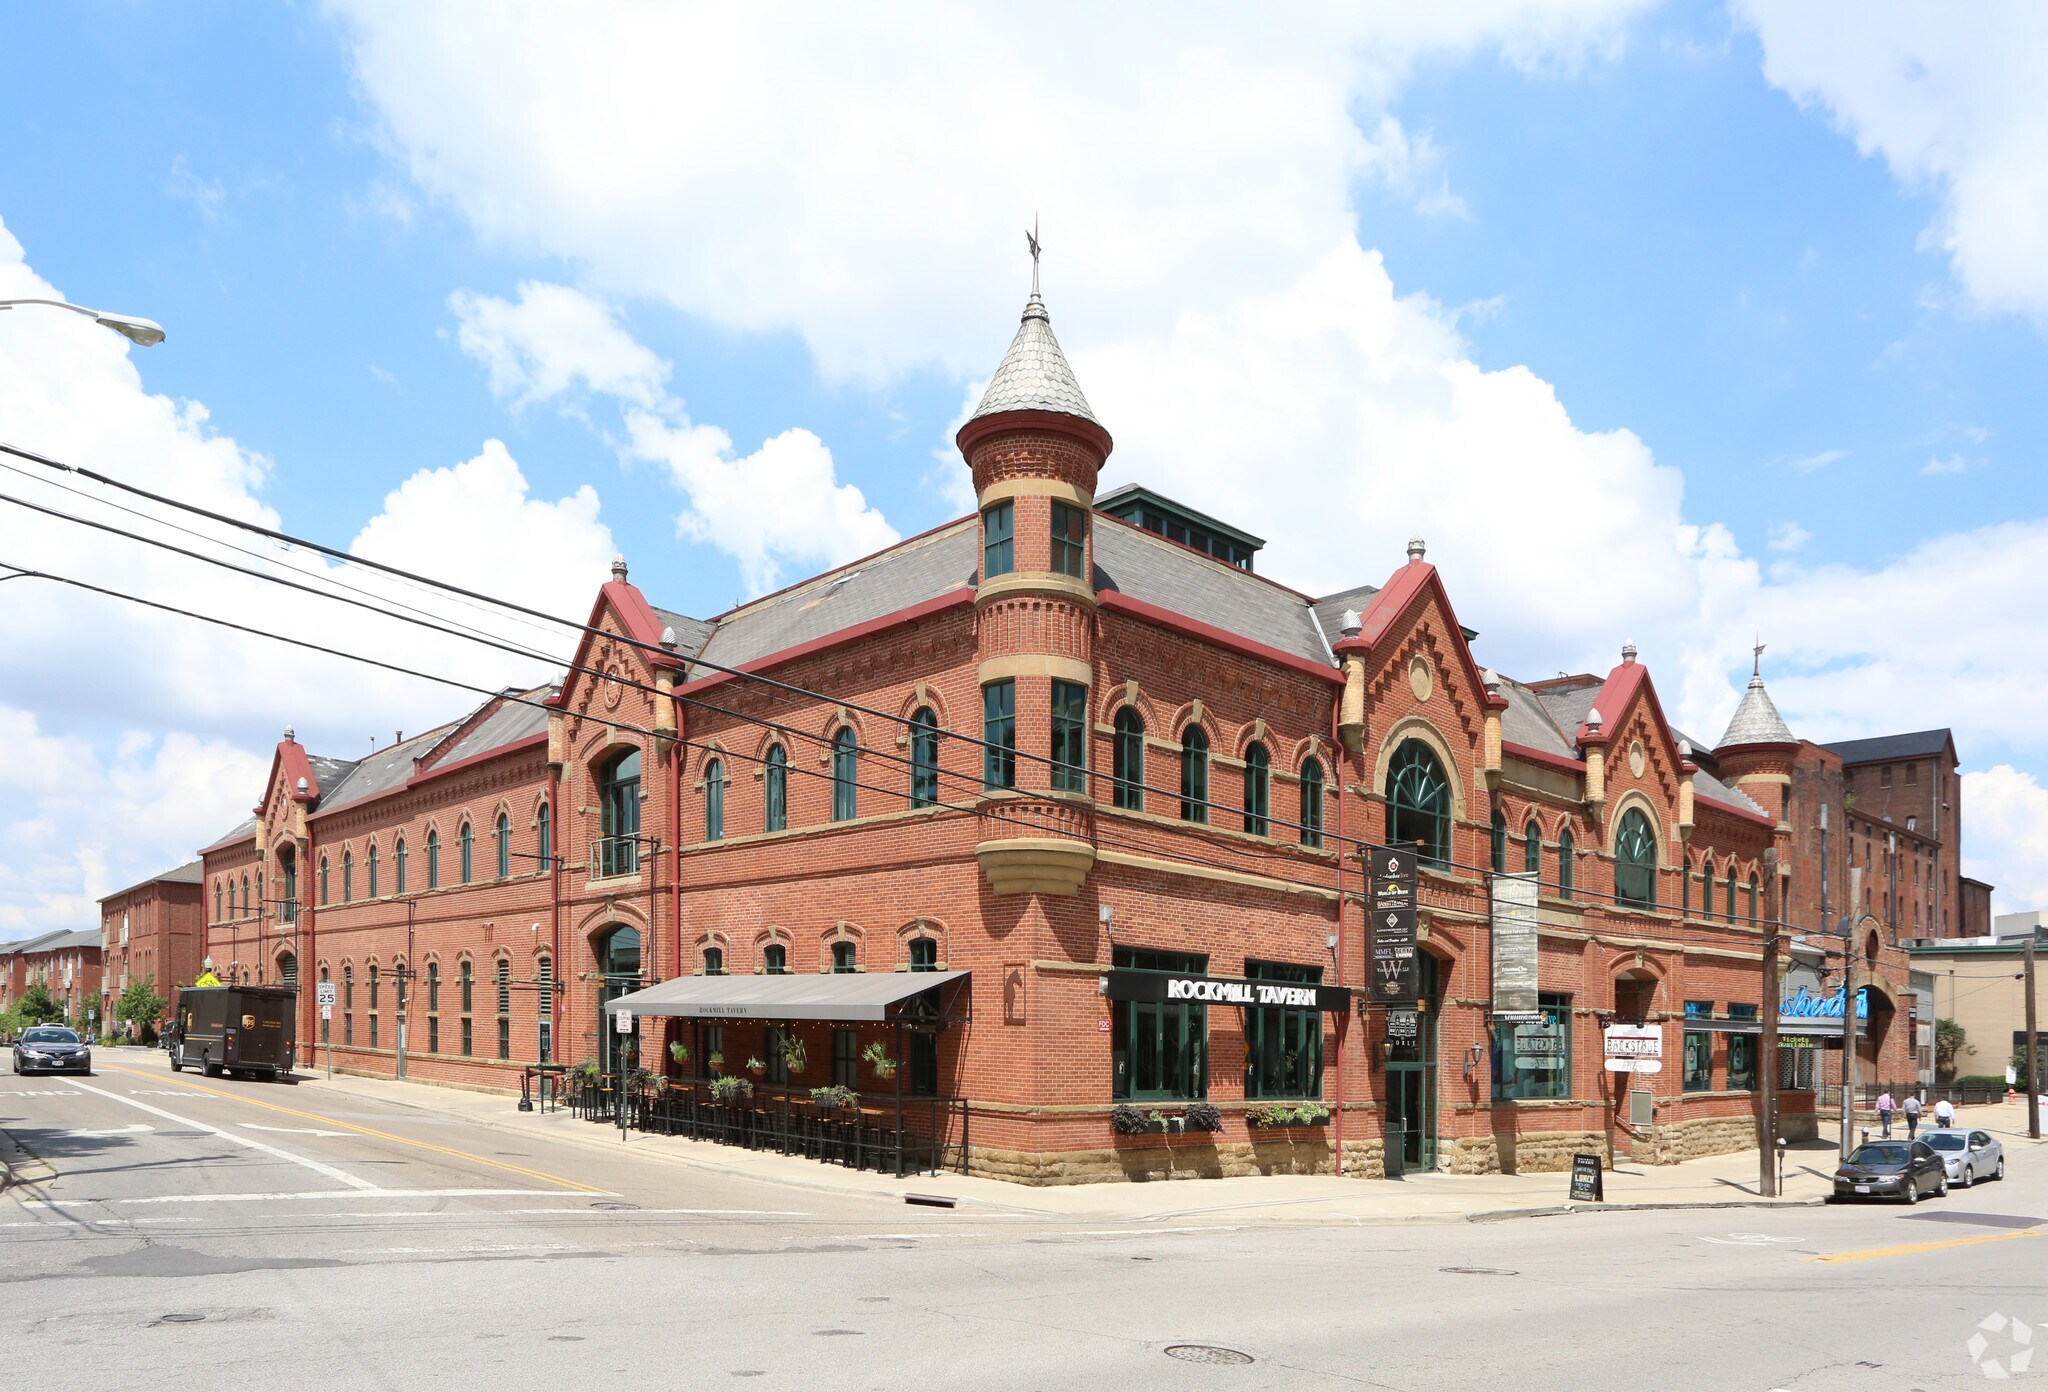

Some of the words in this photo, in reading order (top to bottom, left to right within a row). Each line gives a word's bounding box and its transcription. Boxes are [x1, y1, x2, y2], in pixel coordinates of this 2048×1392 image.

[1167, 979, 1254, 1003] ROCKMILL
[1256, 985, 1317, 1006] TAVERN
[319, 994, 335, 1003] 25
[1779, 985, 1868, 1018] shad
[699, 1006, 725, 1014] ROCKMILL
[1098, 1020, 1110, 1028] FDC
[1607, 1039, 1658, 1052] BACKSTAGE
